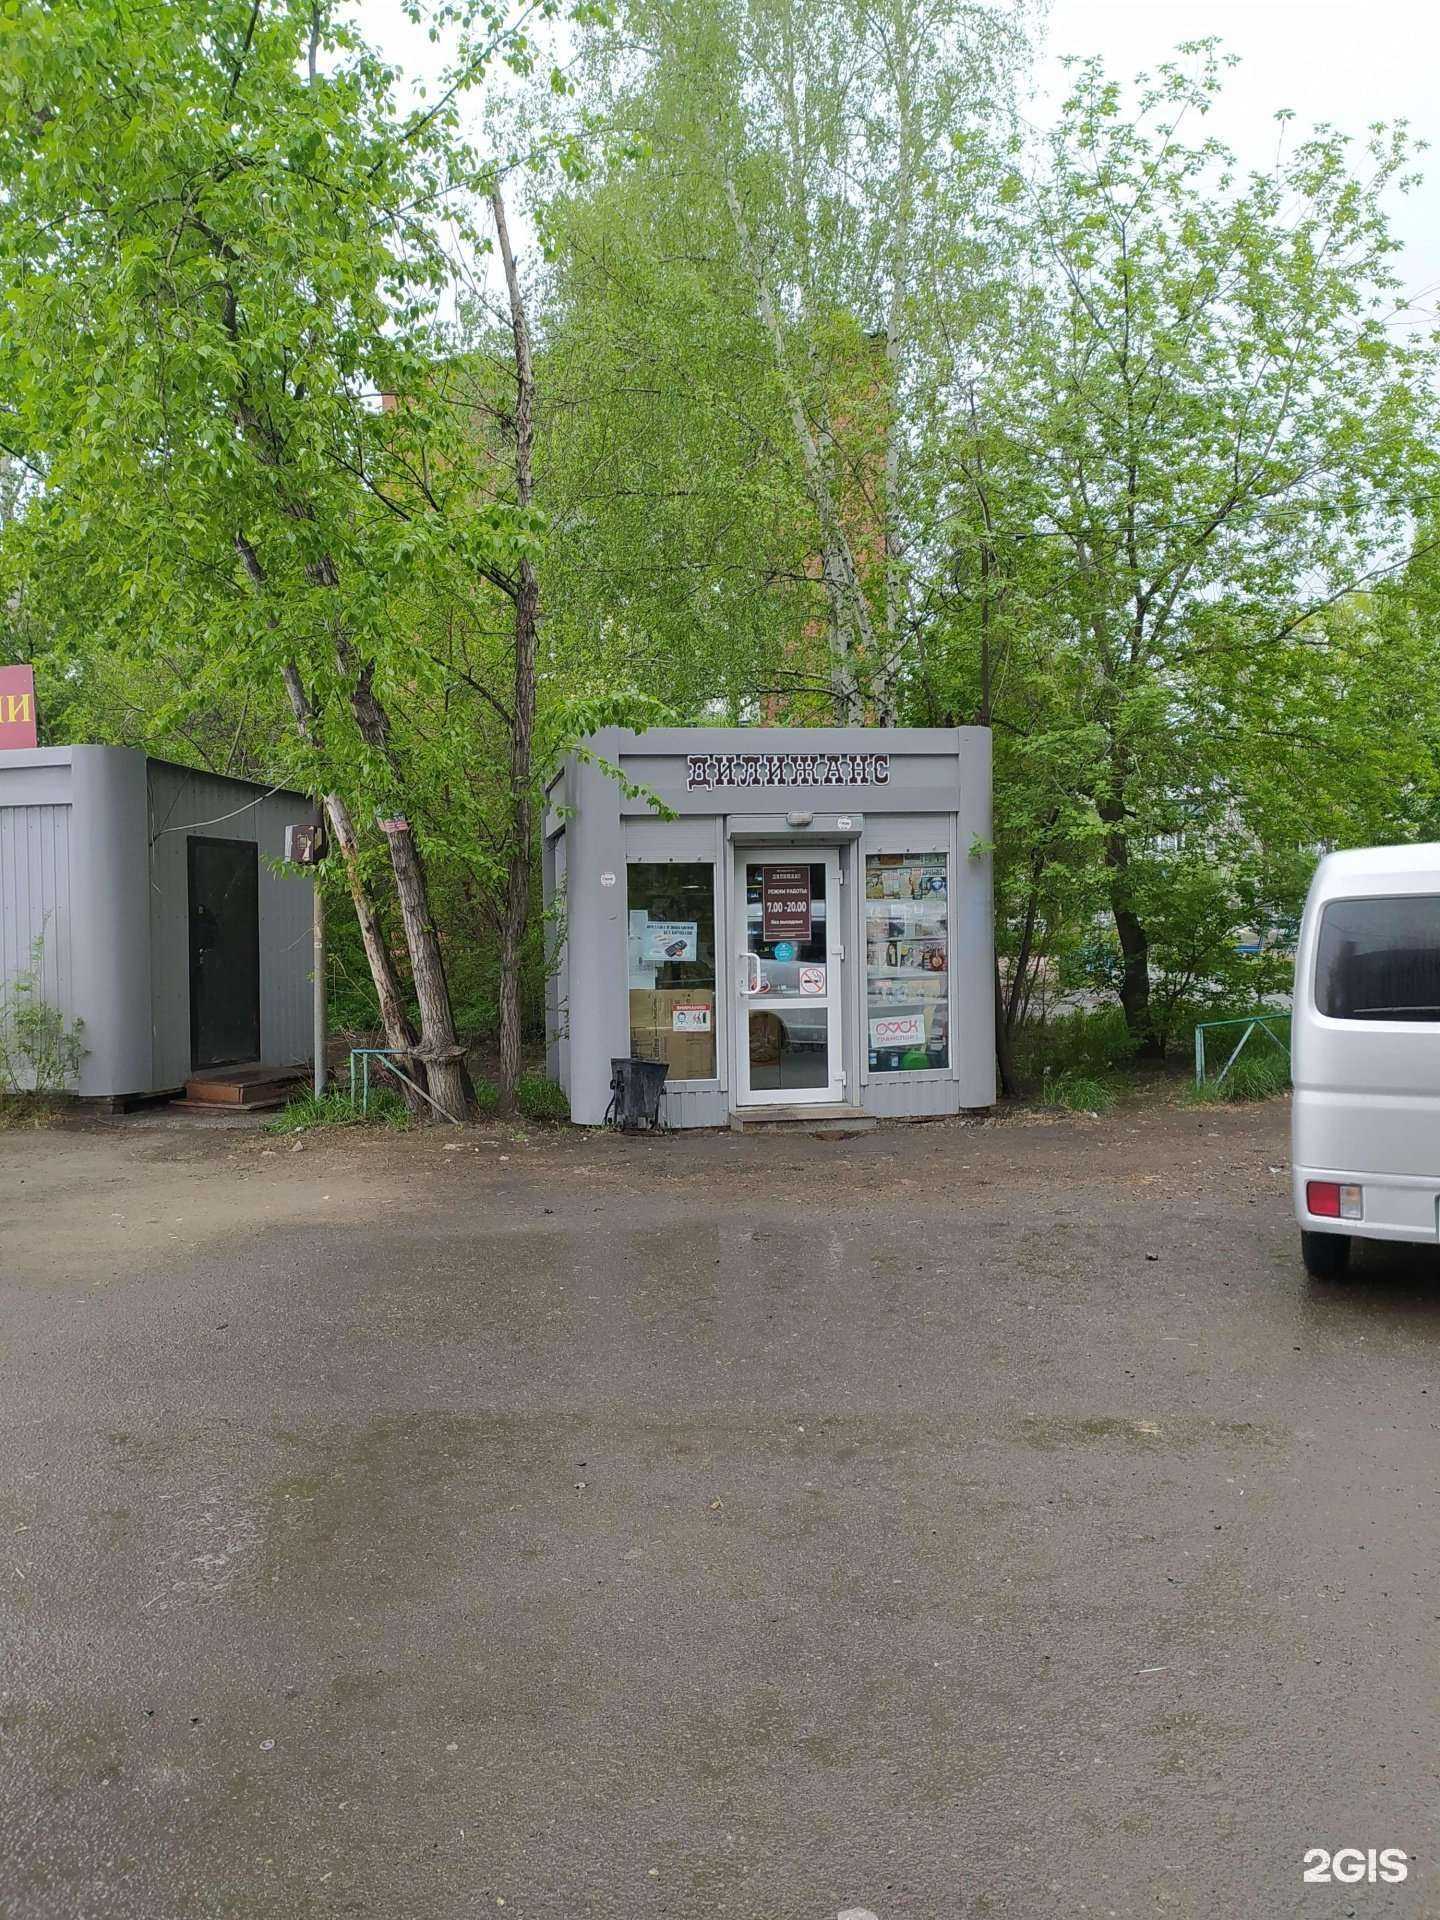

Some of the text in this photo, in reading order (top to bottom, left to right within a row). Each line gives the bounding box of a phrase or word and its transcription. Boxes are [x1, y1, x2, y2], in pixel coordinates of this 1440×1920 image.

[0, 692, 33, 723] И
[687, 754, 890, 791] ДИЛИЖАНС
[767, 901, 783, 912] 7.00
